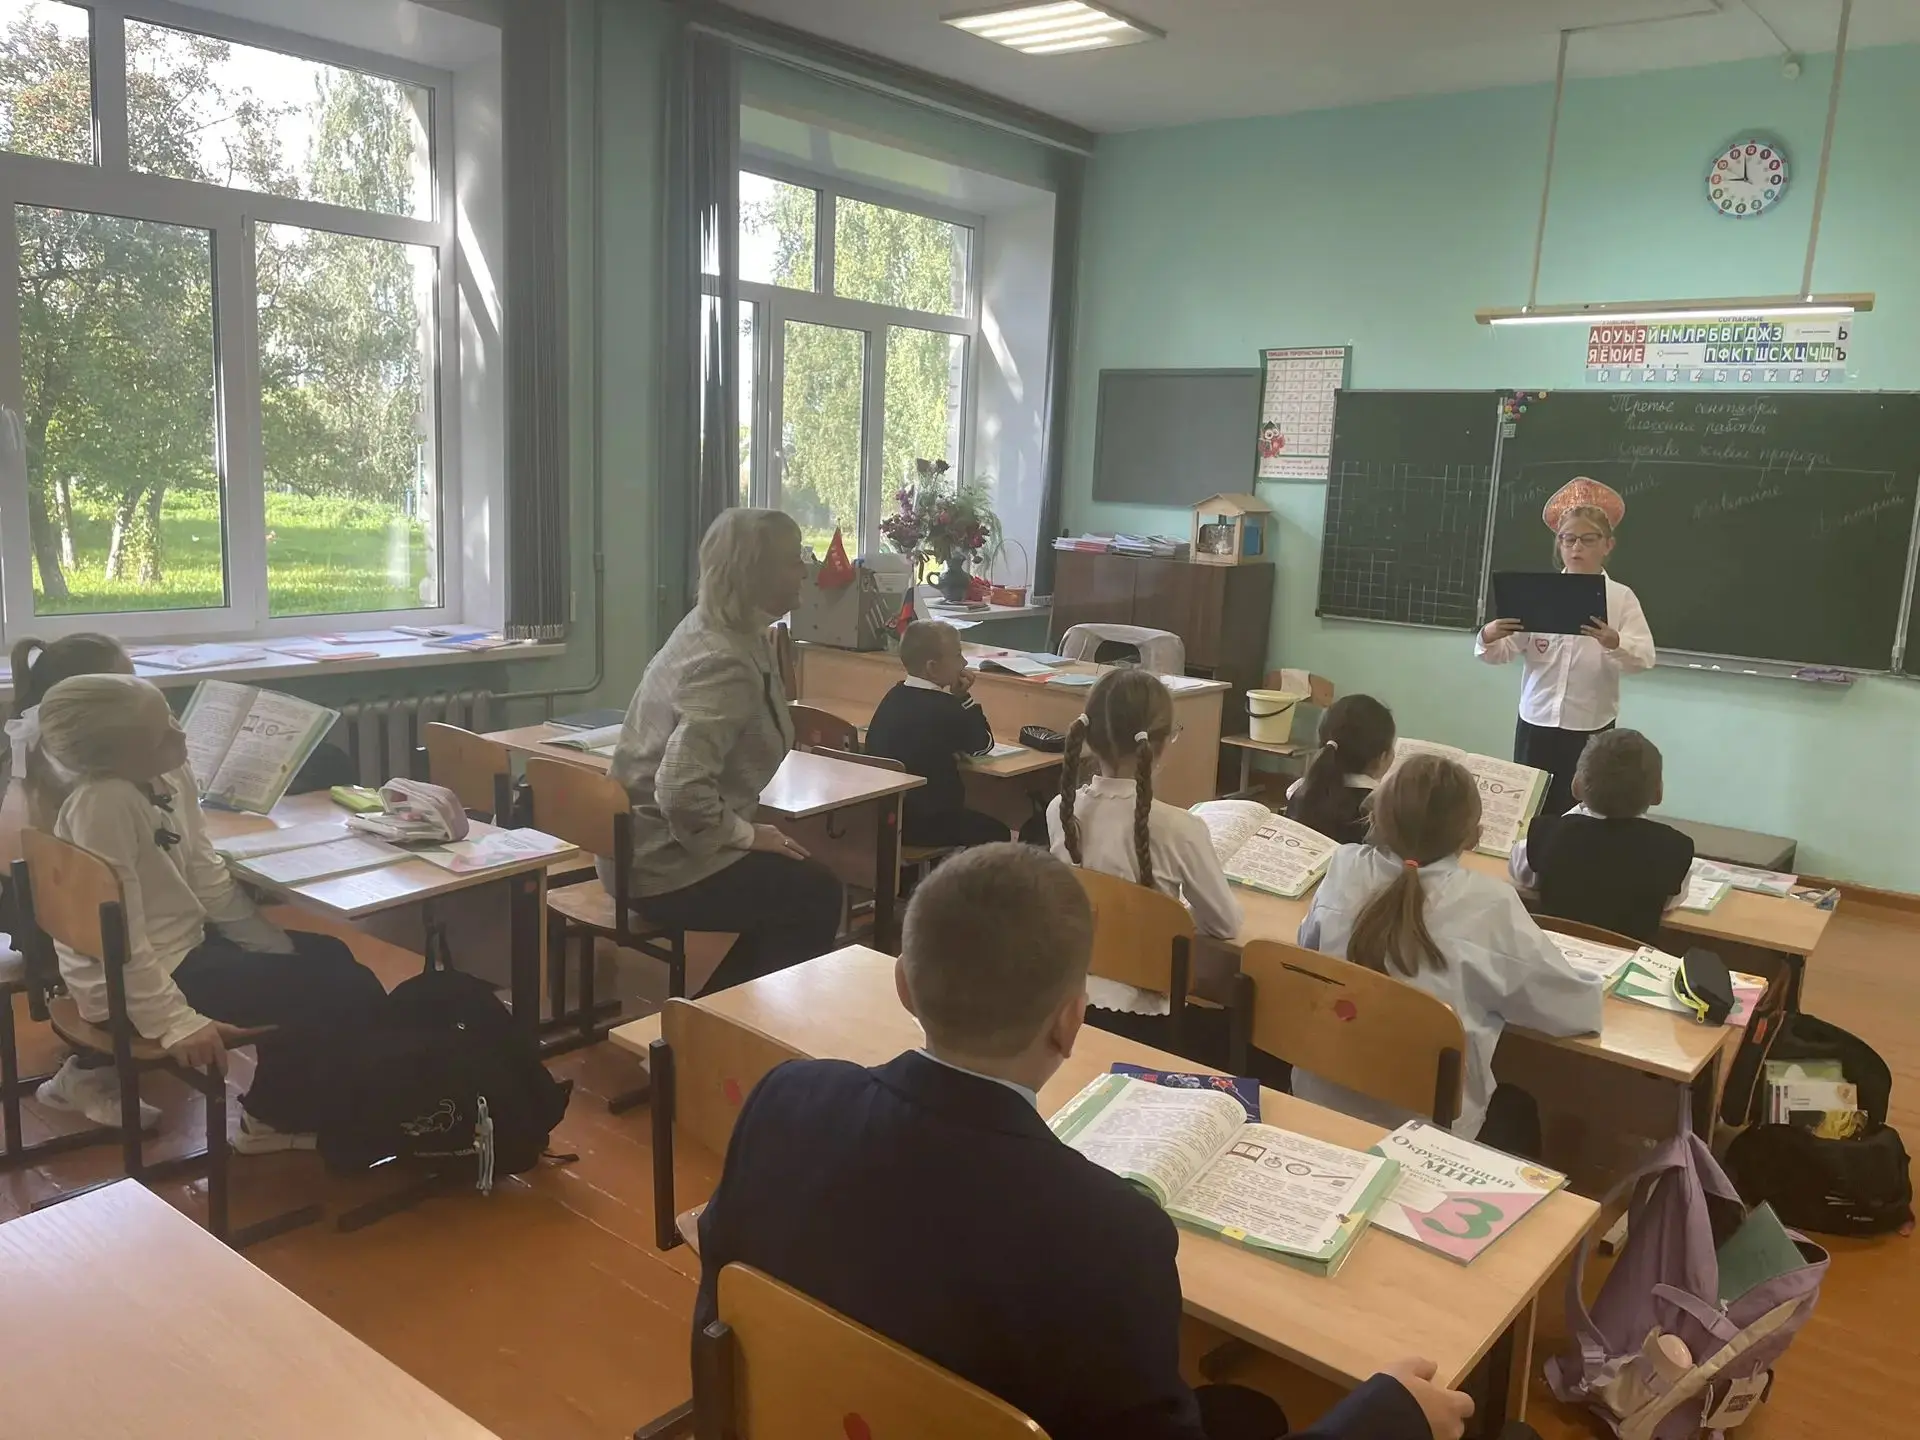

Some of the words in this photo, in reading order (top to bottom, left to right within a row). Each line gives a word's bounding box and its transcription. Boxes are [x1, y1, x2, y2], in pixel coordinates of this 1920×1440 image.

[1717, 315, 1765, 323] СОГЛАСНЫЕ
[1391, 1134, 1517, 1189] Окружающий
[1420, 1158, 1487, 1187] МИР
[1421, 1196, 1506, 1241] 3
